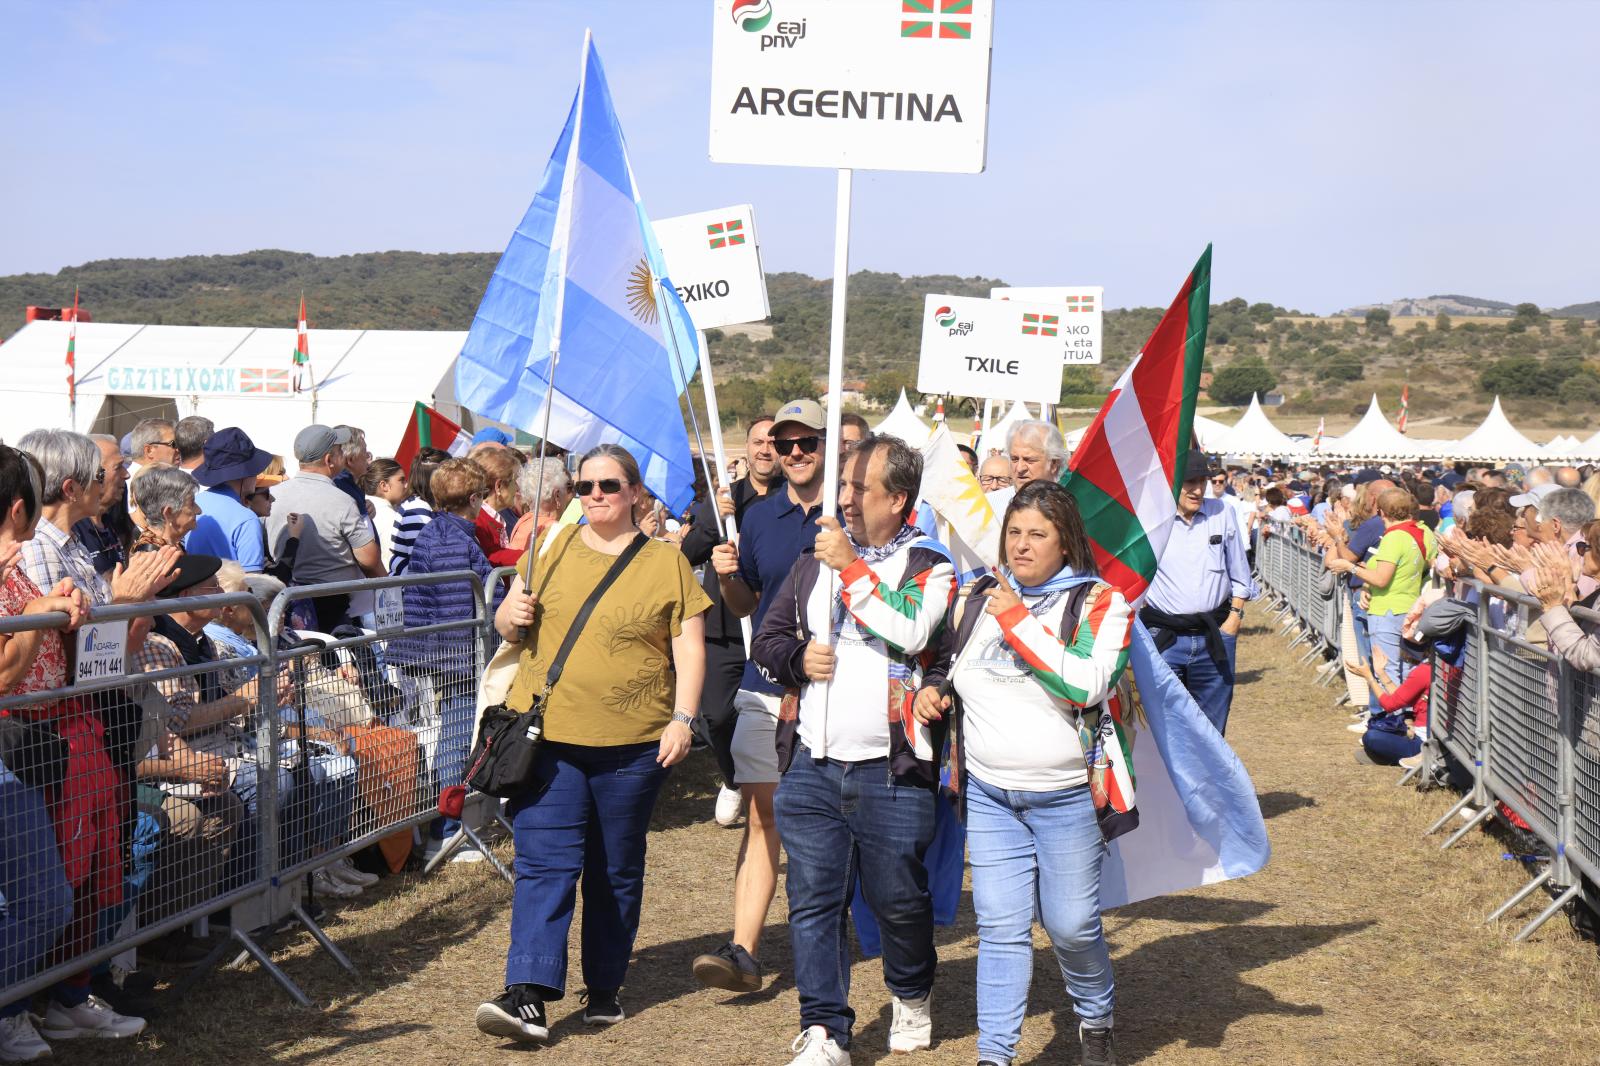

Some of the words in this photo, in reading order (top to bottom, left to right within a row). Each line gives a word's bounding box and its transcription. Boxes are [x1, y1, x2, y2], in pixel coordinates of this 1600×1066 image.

[777, 18, 807, 39] eaj
[760, 34, 798, 51] pnv
[730, 86, 963, 123] ARGENTINA
[949, 328, 969, 337] pnv
[957, 320, 974, 332] eaj
[1073, 337, 1093, 348] eta
[965, 356, 1019, 375] TXILE
[108, 367, 236, 392] GAZTETXOAK
[79, 661, 93, 678] 944
[94, 659, 107, 676] 711
[108, 657, 123, 674] 441
